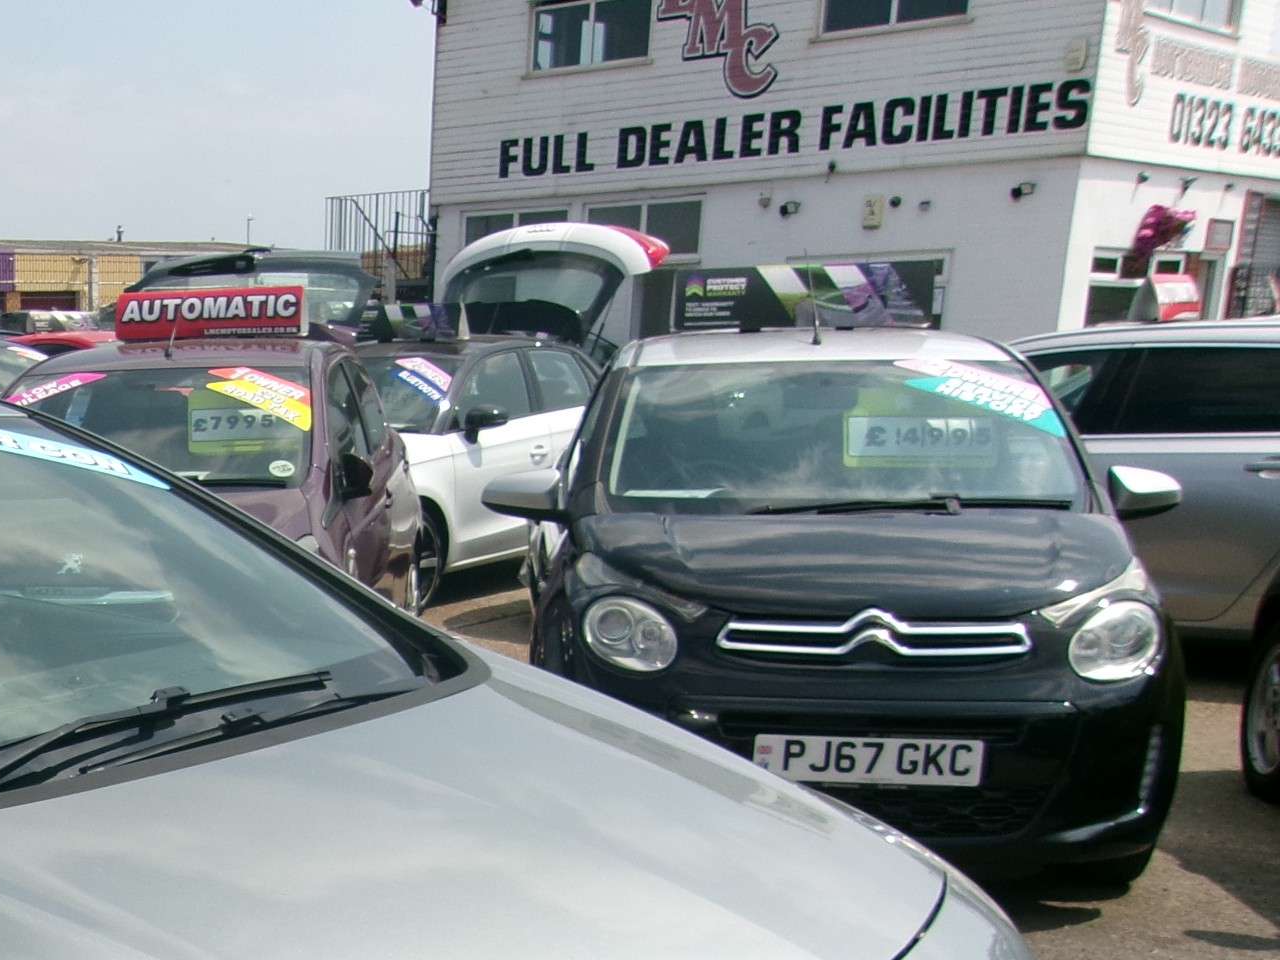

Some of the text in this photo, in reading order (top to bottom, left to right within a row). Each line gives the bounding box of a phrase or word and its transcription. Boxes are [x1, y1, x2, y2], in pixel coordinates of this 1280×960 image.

[657, 0, 780, 99] MC
[498, 78, 1092, 180] FULL DEALER FACILITIES
[1169, 92, 1234, 150] 01323
[120, 294, 297, 323] AUTOMATIC
[22, 380, 58, 399] LOW
[243, 373, 305, 399] OWNER
[193, 414, 274, 432] £7995
[28, 440, 133, 476] CON
[781, 739, 973, 776] PJ67 GKC
